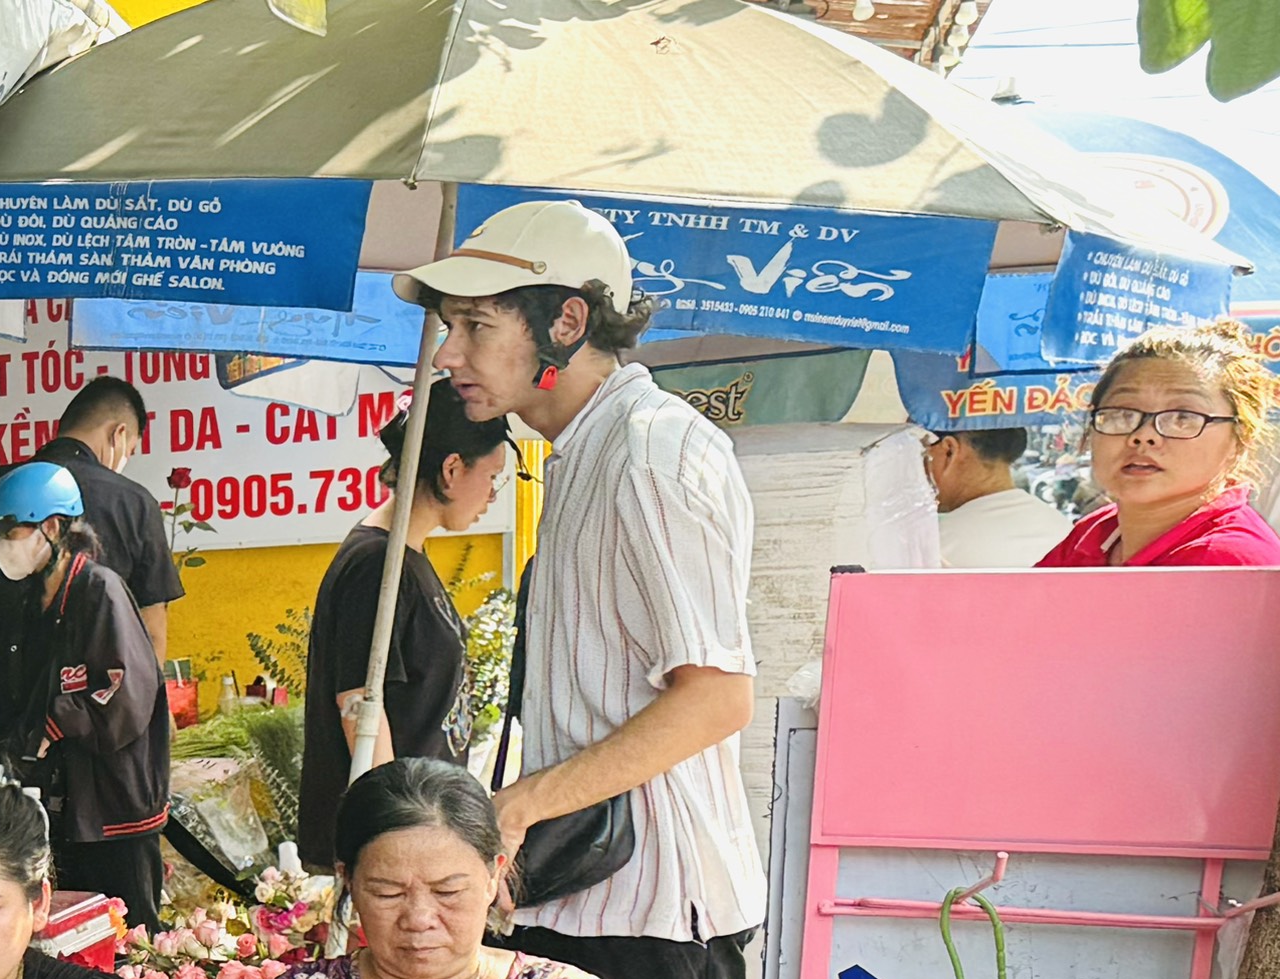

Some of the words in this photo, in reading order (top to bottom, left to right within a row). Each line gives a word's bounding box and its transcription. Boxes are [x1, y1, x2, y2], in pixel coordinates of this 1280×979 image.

[53, 195, 90, 211] LÀM
[95, 195, 118, 211] DÙ
[167, 197, 193, 213] DÙ
[52, 214, 76, 229] DÙ
[144, 215, 179, 231] CÁO
[648, 211, 730, 231] TNHH
[739, 218, 783, 236] TM
[788, 223, 810, 239] &
[817, 225, 860, 243] DV
[52, 232, 73, 247] DÙ
[77, 232, 109, 250] LỆCH
[157, 235, 197, 251] TRÒN
[220, 258, 276, 275] PHÒNG
[20, 268, 41, 283] VÀ
[47, 269, 90, 284] ĐÓNG
[94, 269, 128, 285] MỚI
[132, 271, 165, 287] GHẾ
[22, 340, 85, 395] TÓC
[941, 377, 1018, 418] YẾN
[170, 406, 223, 453] DA
